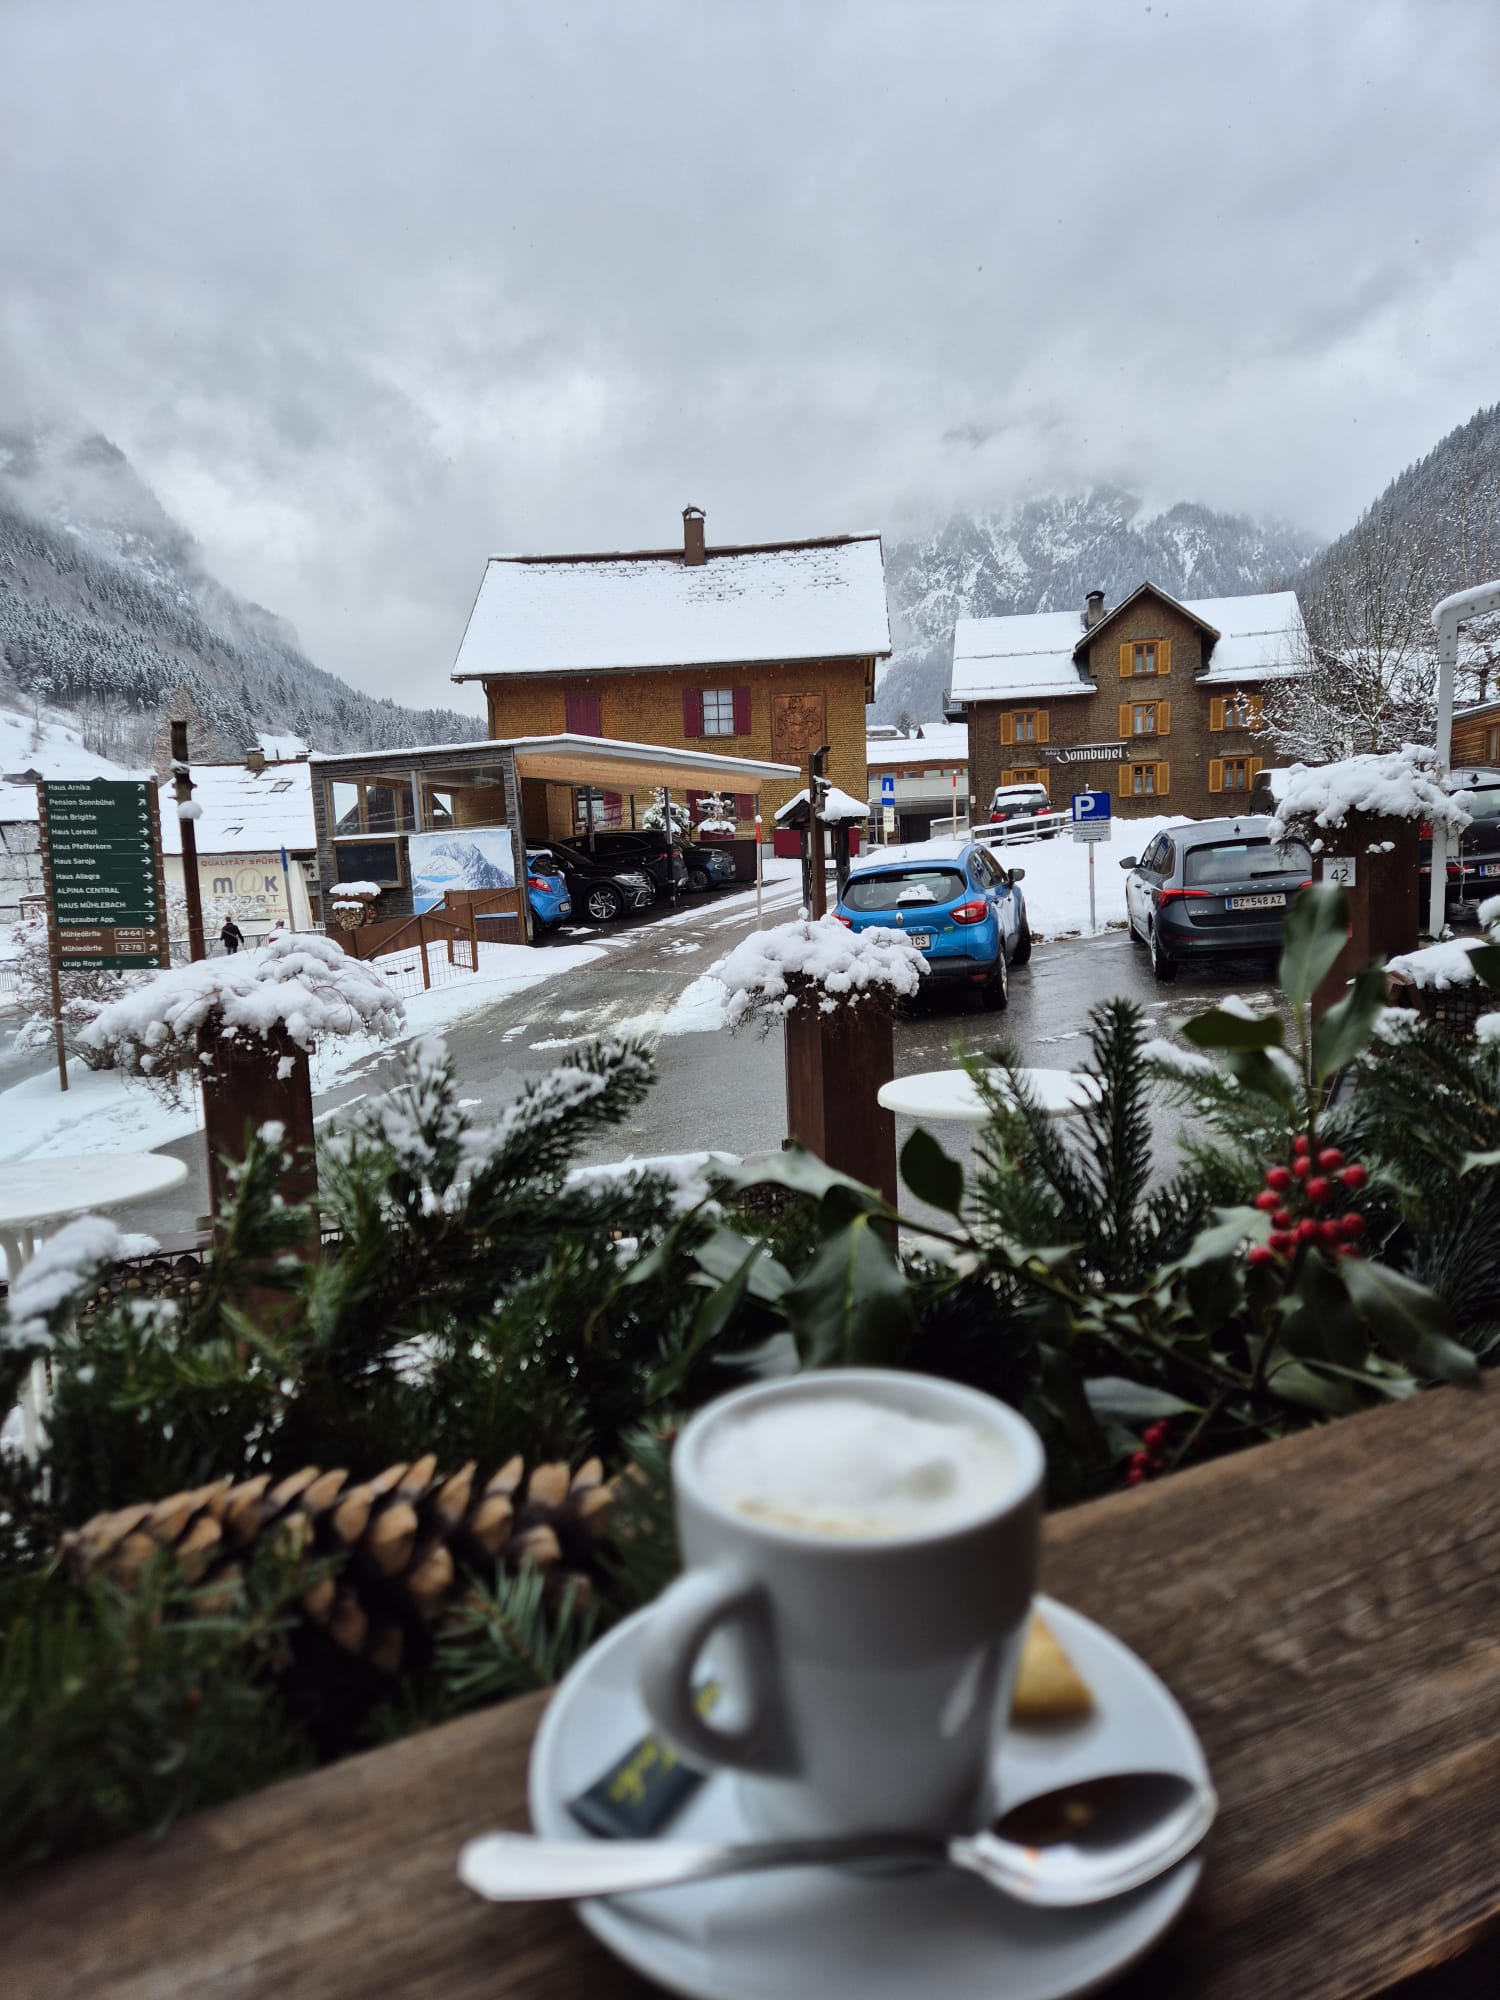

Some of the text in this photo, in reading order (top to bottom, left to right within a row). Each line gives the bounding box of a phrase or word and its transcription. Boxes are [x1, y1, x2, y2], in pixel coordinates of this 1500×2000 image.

[1075, 796, 1095, 821] P
[69, 813, 97, 821] Brigitte
[71, 828, 97, 836] Lorenzi
[73, 857, 96, 865] Saroja
[201, 857, 282, 867] QUALITÄT SPÜRE
[75, 873, 101, 881] Allegra
[1330, 868, 1349, 882] 42
[80, 901, 127, 909] MÜHLEBACH
[1233, 895, 1282, 908] BZ 548 AZ
[100, 916, 117, 924] App.
[60, 930, 101, 938] Mühledörfle
[62, 960, 103, 968] Uralp Royal
